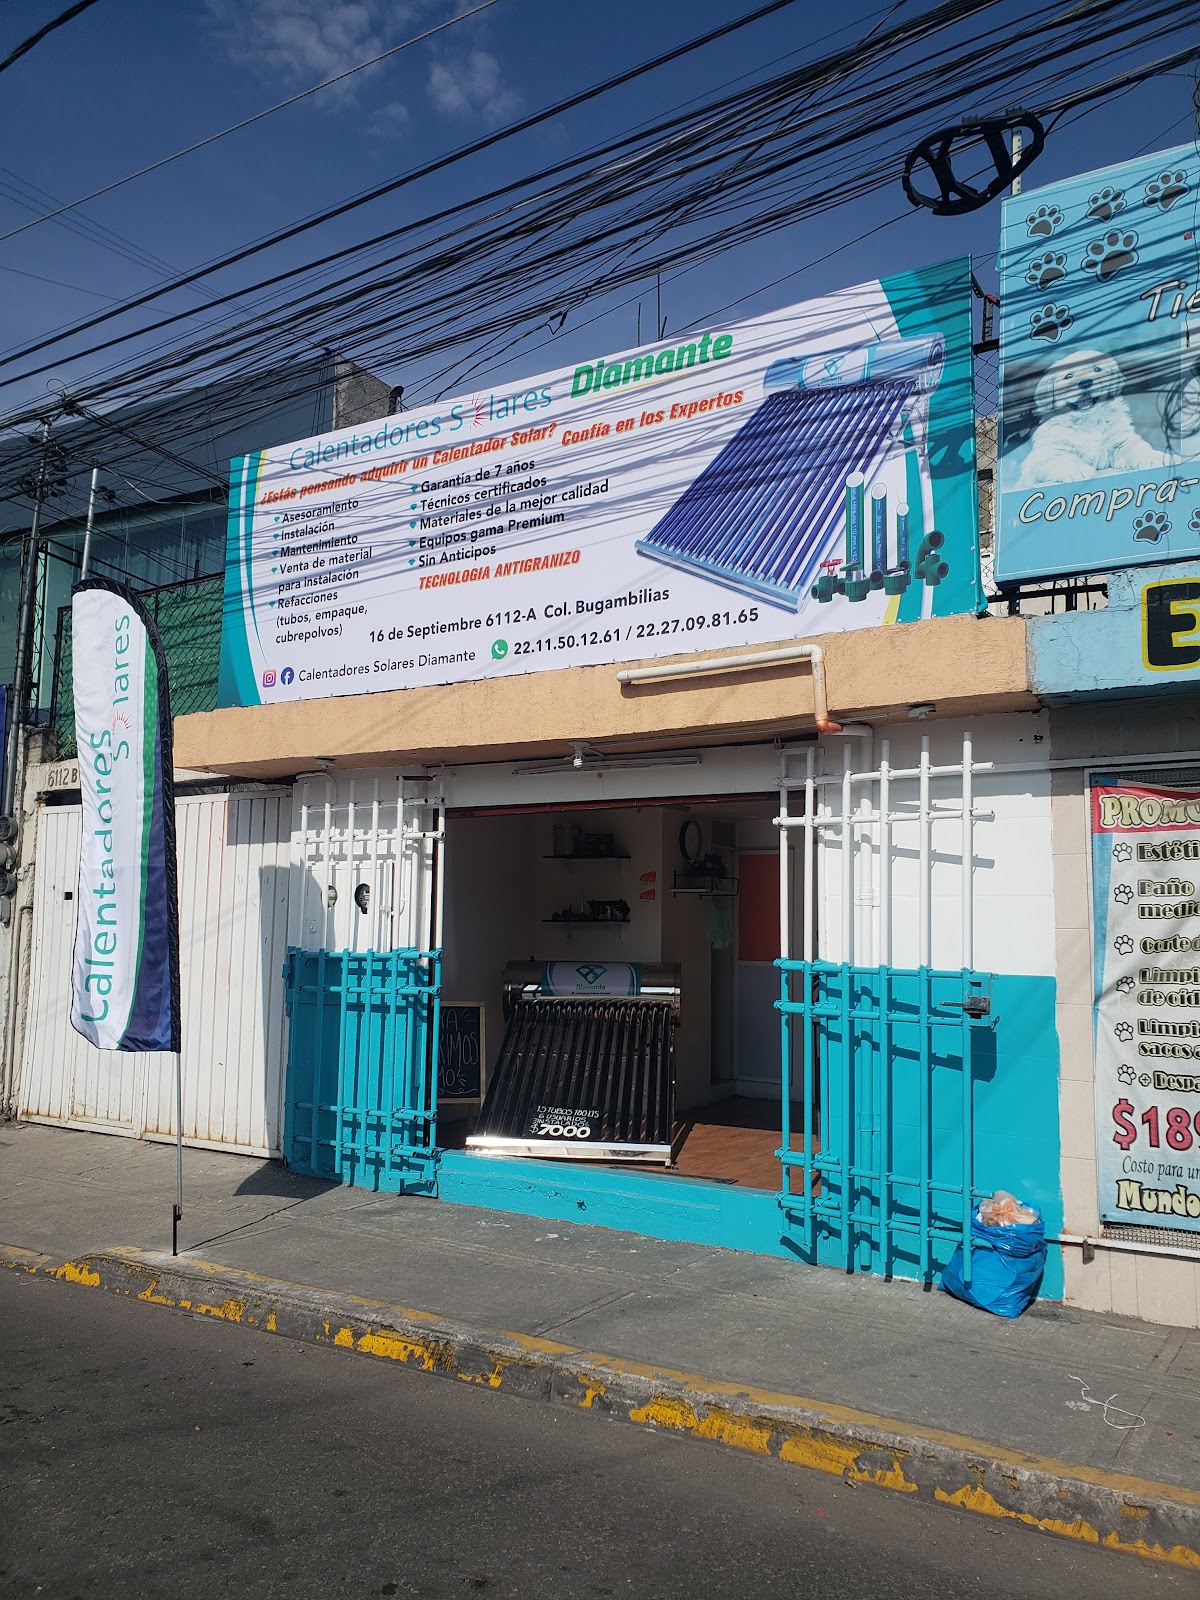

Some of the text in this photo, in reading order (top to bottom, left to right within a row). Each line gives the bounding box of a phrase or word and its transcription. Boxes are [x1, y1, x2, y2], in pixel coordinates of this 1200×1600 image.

[571, 333, 733, 399] Diamante
[290, 385, 552, 471] Calentadores Slares
[260, 390, 744, 505] ¿Estás pensando adquirir un Calentador Solar? Confía en los Expertos
[421, 459, 535, 493] Garantía de 7 años
[420, 479, 609, 530] Materiales de la mejor calidad
[421, 476, 547, 511] Técnicos certificados
[281, 499, 359, 524] Asesoramiento
[281, 520, 335, 541] Instalación
[419, 513, 565, 549] Equipos gama Premium
[280, 534, 358, 558] Mantenimiento
[418, 543, 496, 568] Sin Anticipos
[279, 547, 372, 575] Venta de material
[419, 549, 581, 590] TECNOLOGIA ANTIGRANIZO
[278, 568, 359, 595] para instalación
[278, 592, 338, 610] Refacciones
[276, 604, 368, 629] (tubos, empaque,
[369, 588, 669, 644] 16 de Septiembre 6112-A Col. Bugambilias
[275, 624, 343, 644] cubrepolvos)
[514, 629, 620, 655] 22.11.50.12.61
[636, 607, 759, 638] 22.27.09.81.65
[299, 650, 476, 682] Calentadores Solares Diamante
[48, 768, 78, 787] 6112 B
[81, 728, 118, 1022] Calentadores
[1138, 878, 1195, 897] Baño
[1140, 934, 1192, 954] Corte
[1137, 989, 1166, 1006] de
[1137, 1018, 1200, 1038] Limpi
[1138, 1041, 1193, 1059] sacos
[546, 1114, 587, 1122] USUARIOS
[547, 1107, 573, 1115] TUBOS
[1112, 1098, 1200, 1151] $18
[1122, 1155, 1154, 1174] Costo
[1157, 1163, 1184, 1181] para
[1116, 1179, 1200, 1218] Mundo
